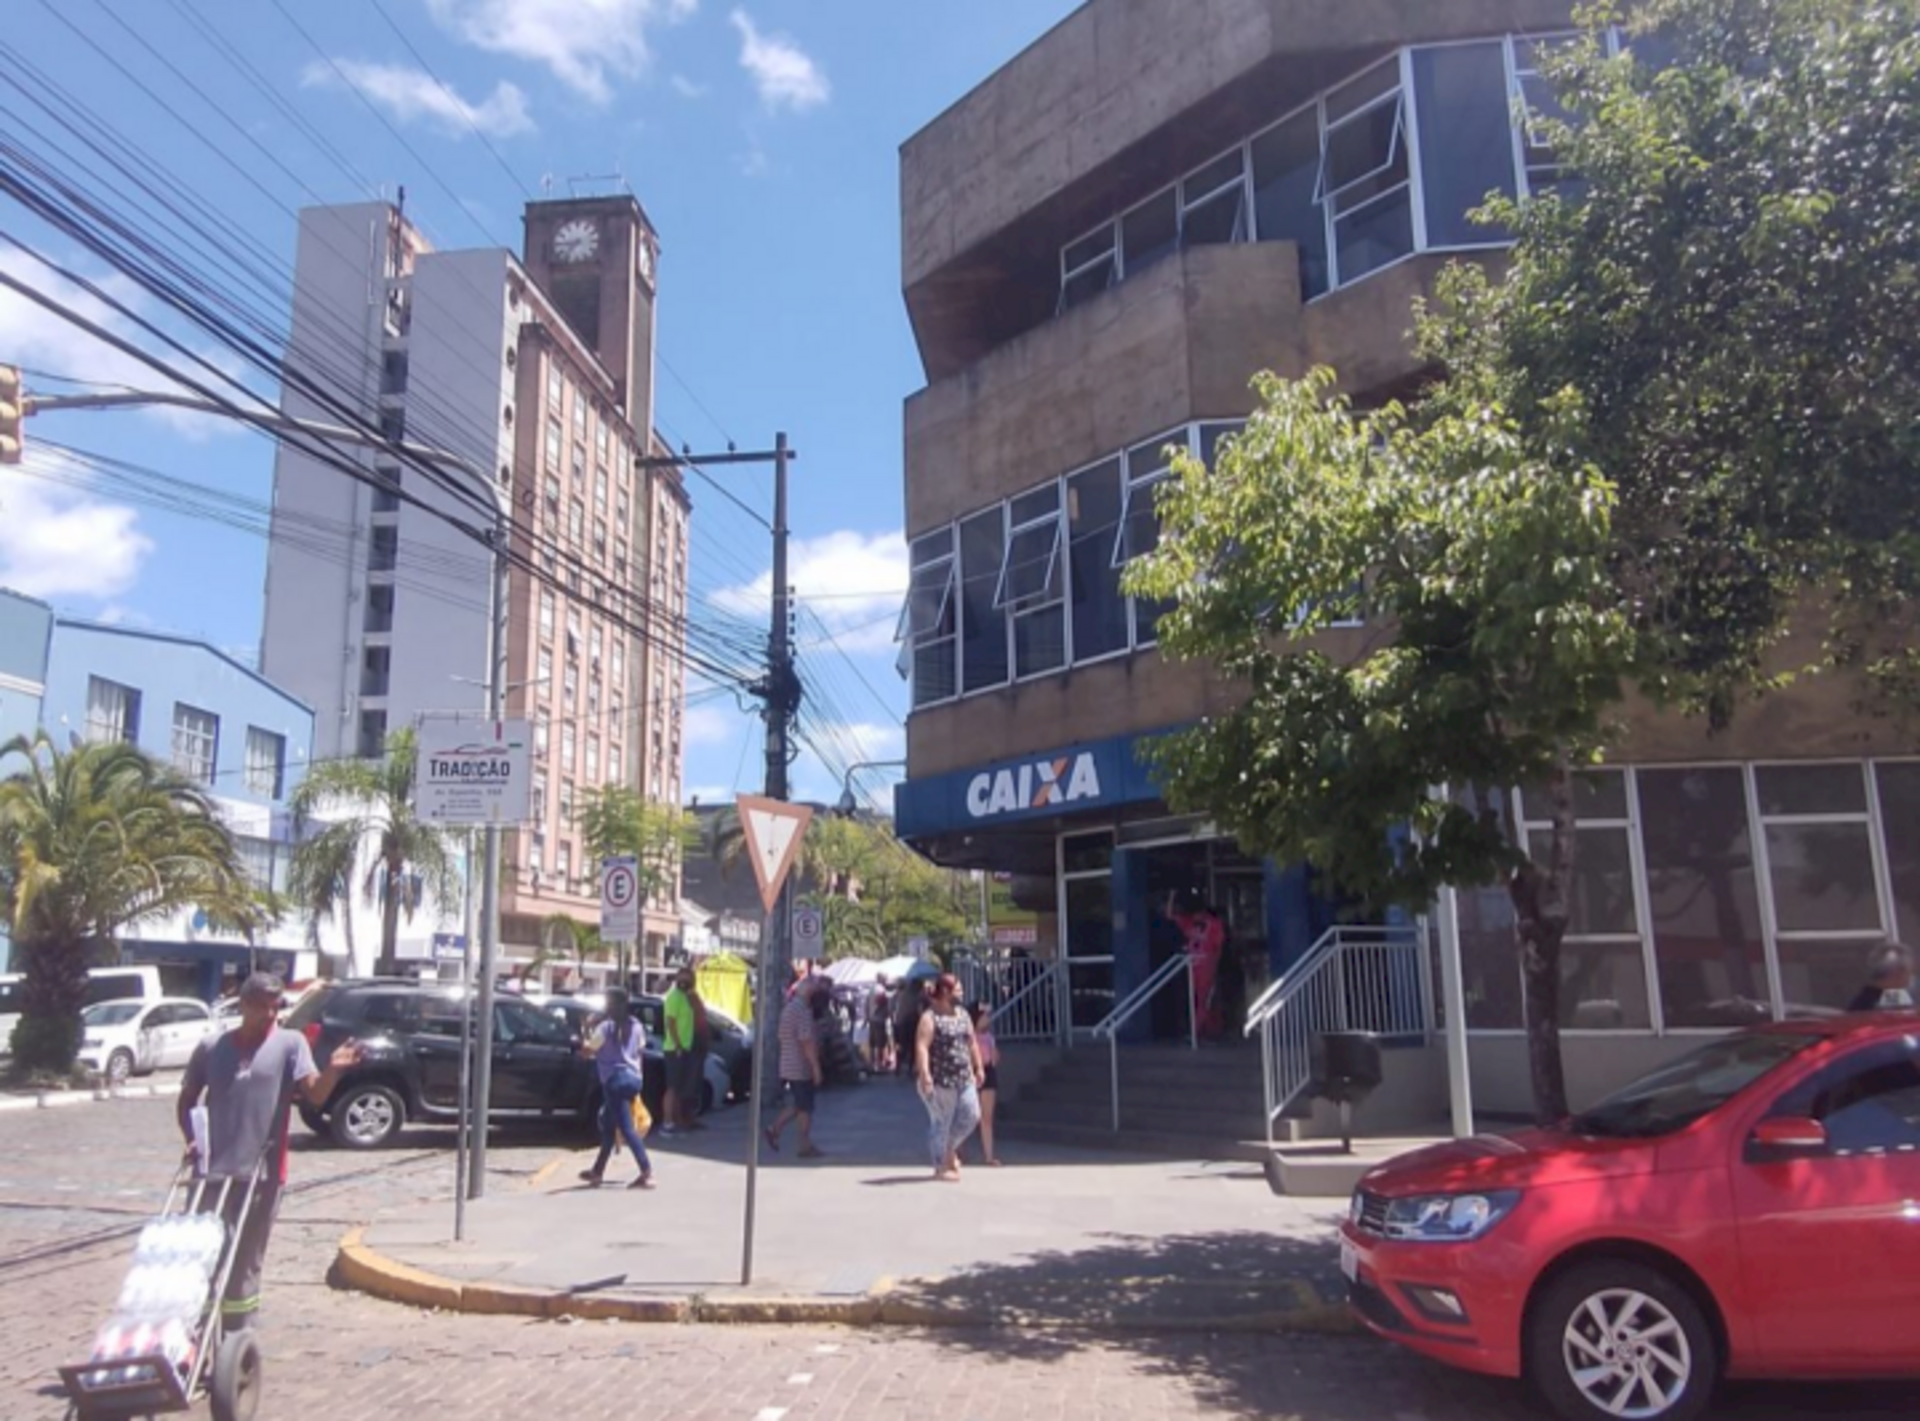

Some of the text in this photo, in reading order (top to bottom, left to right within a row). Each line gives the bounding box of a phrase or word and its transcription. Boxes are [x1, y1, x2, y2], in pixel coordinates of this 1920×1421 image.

[967, 752, 1100, 816] CAIXA
[613, 874, 624, 899] E
[802, 919, 811, 934] E
